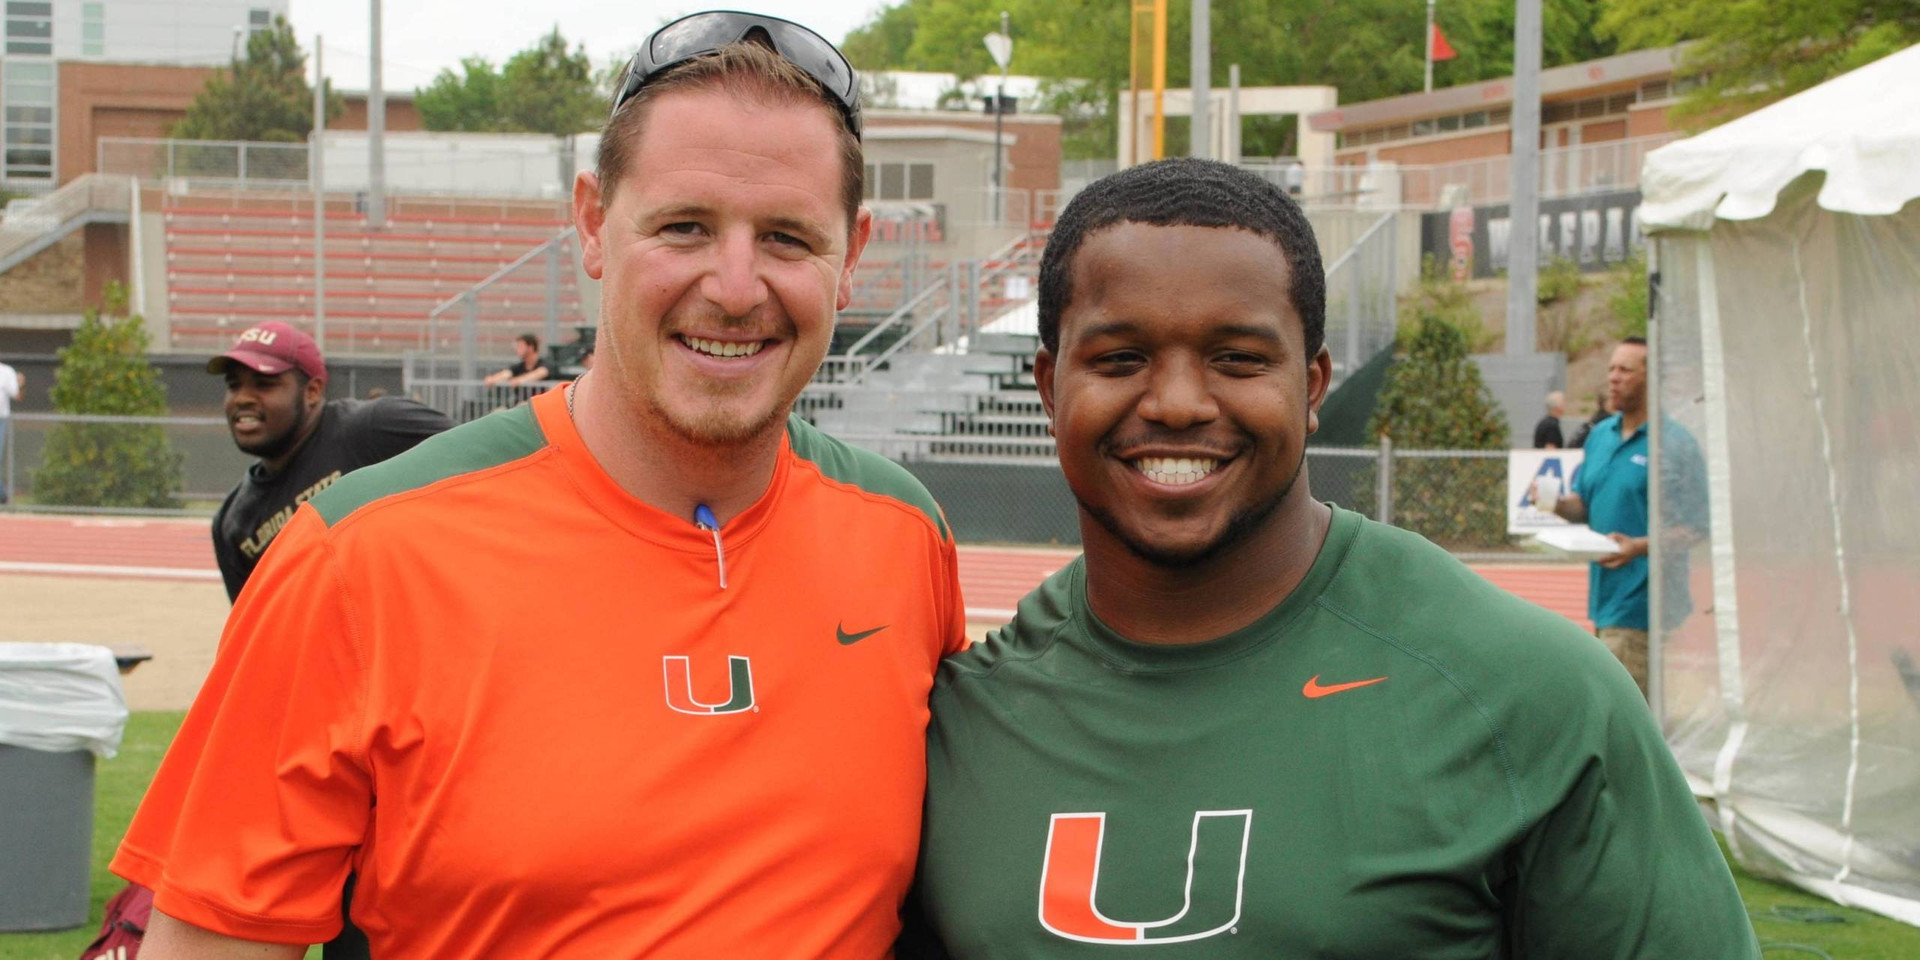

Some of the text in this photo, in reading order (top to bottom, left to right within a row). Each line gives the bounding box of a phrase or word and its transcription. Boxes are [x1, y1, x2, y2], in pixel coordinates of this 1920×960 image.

[1487, 206, 1641, 266] WLFPA
[662, 655, 755, 715] U
[1038, 809, 1253, 945] U
